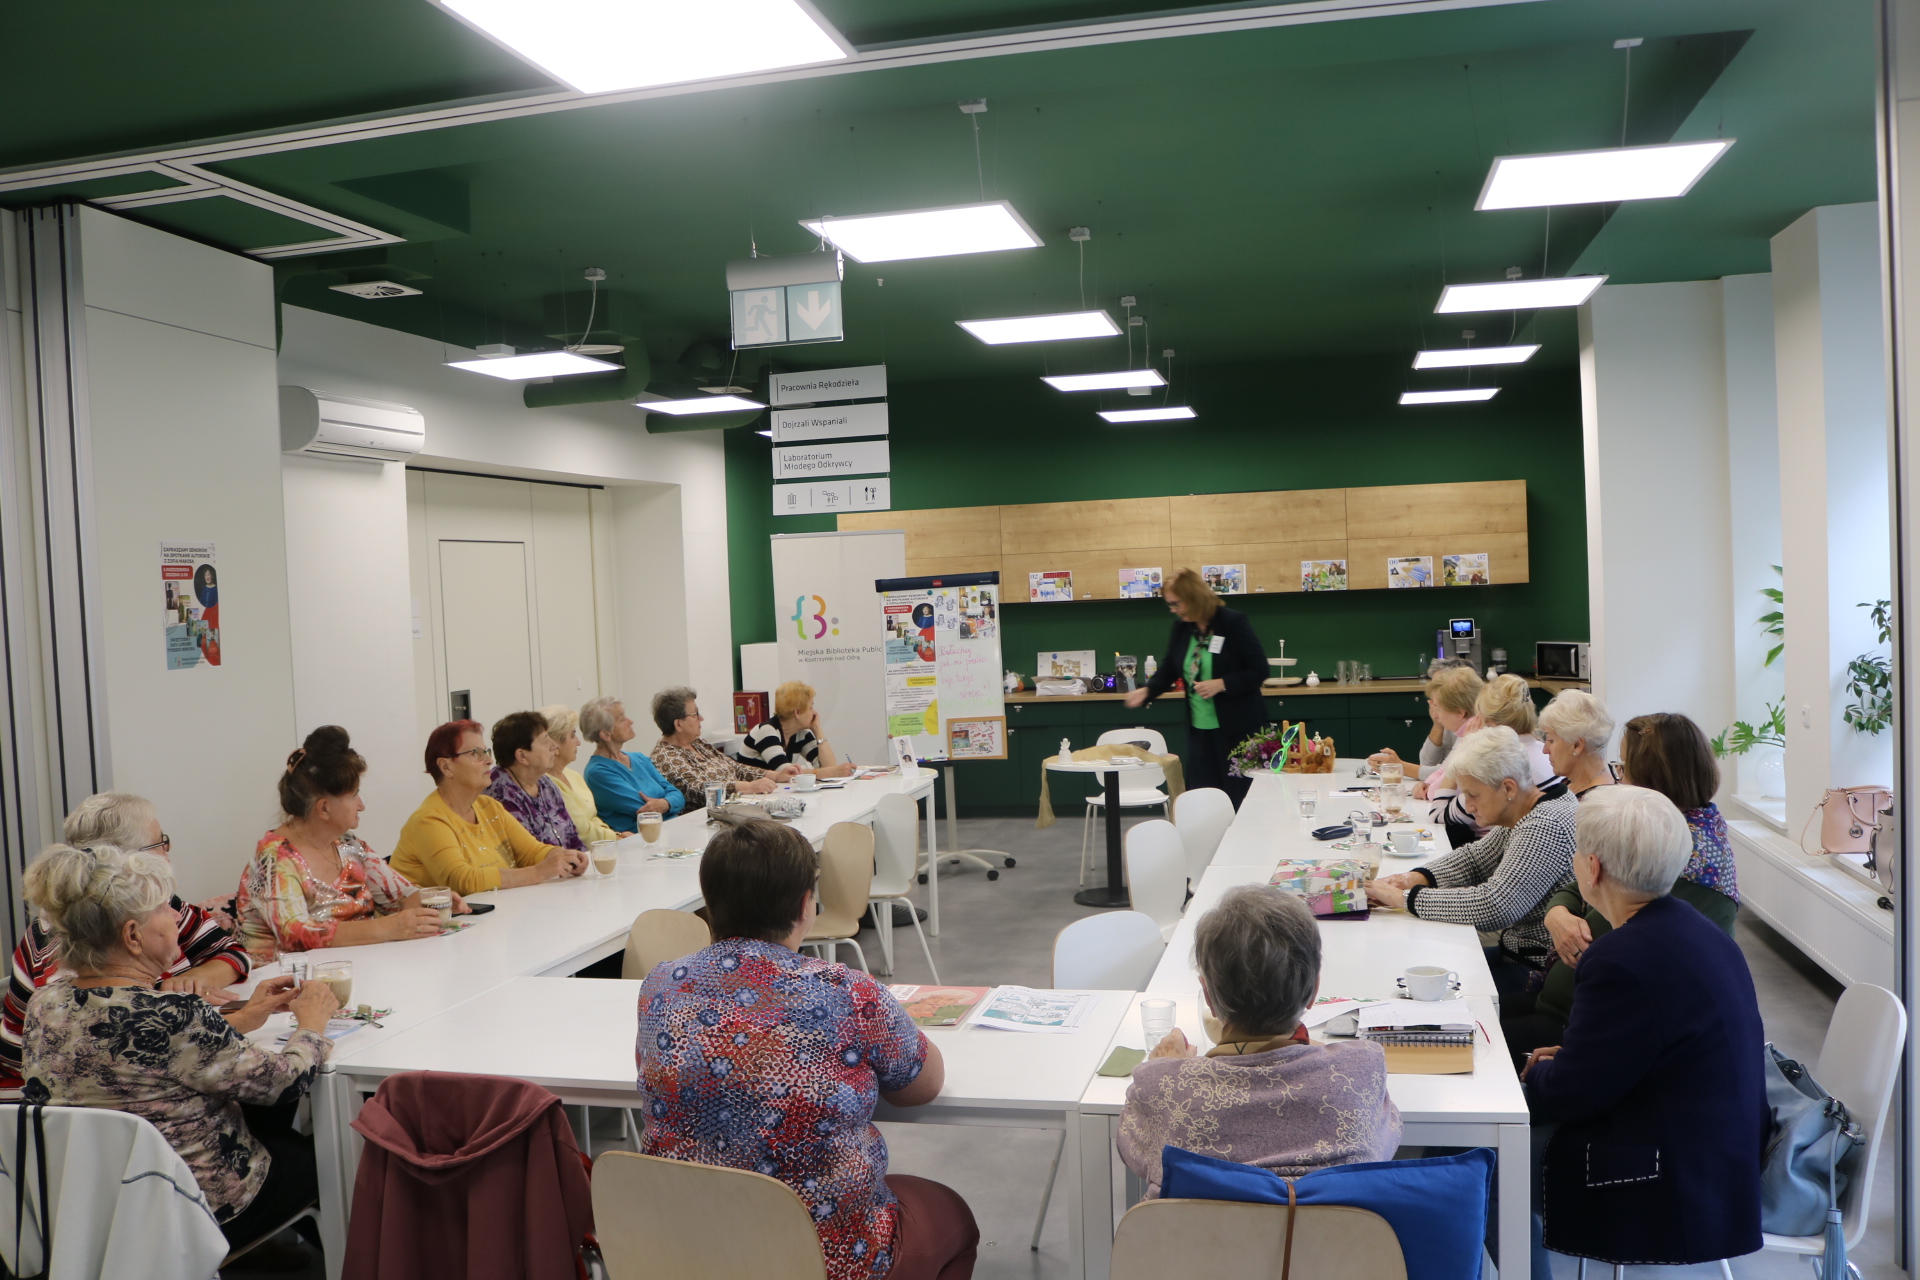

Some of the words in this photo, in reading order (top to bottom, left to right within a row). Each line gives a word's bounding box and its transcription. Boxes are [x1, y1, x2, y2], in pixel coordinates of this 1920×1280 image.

[781, 382, 817, 392] Pracownia
[818, 379, 860, 390] Rękodzieła
[782, 420, 810, 429] Dojrzali
[811, 417, 848, 428] Wspaniali
[783, 452, 833, 462] Laboratorium
[784, 461, 816, 471] Młodego
[817, 460, 853, 468] Odkrywcy
[797, 648, 824, 657] Miejska
[826, 646, 860, 655] Biblioteka
